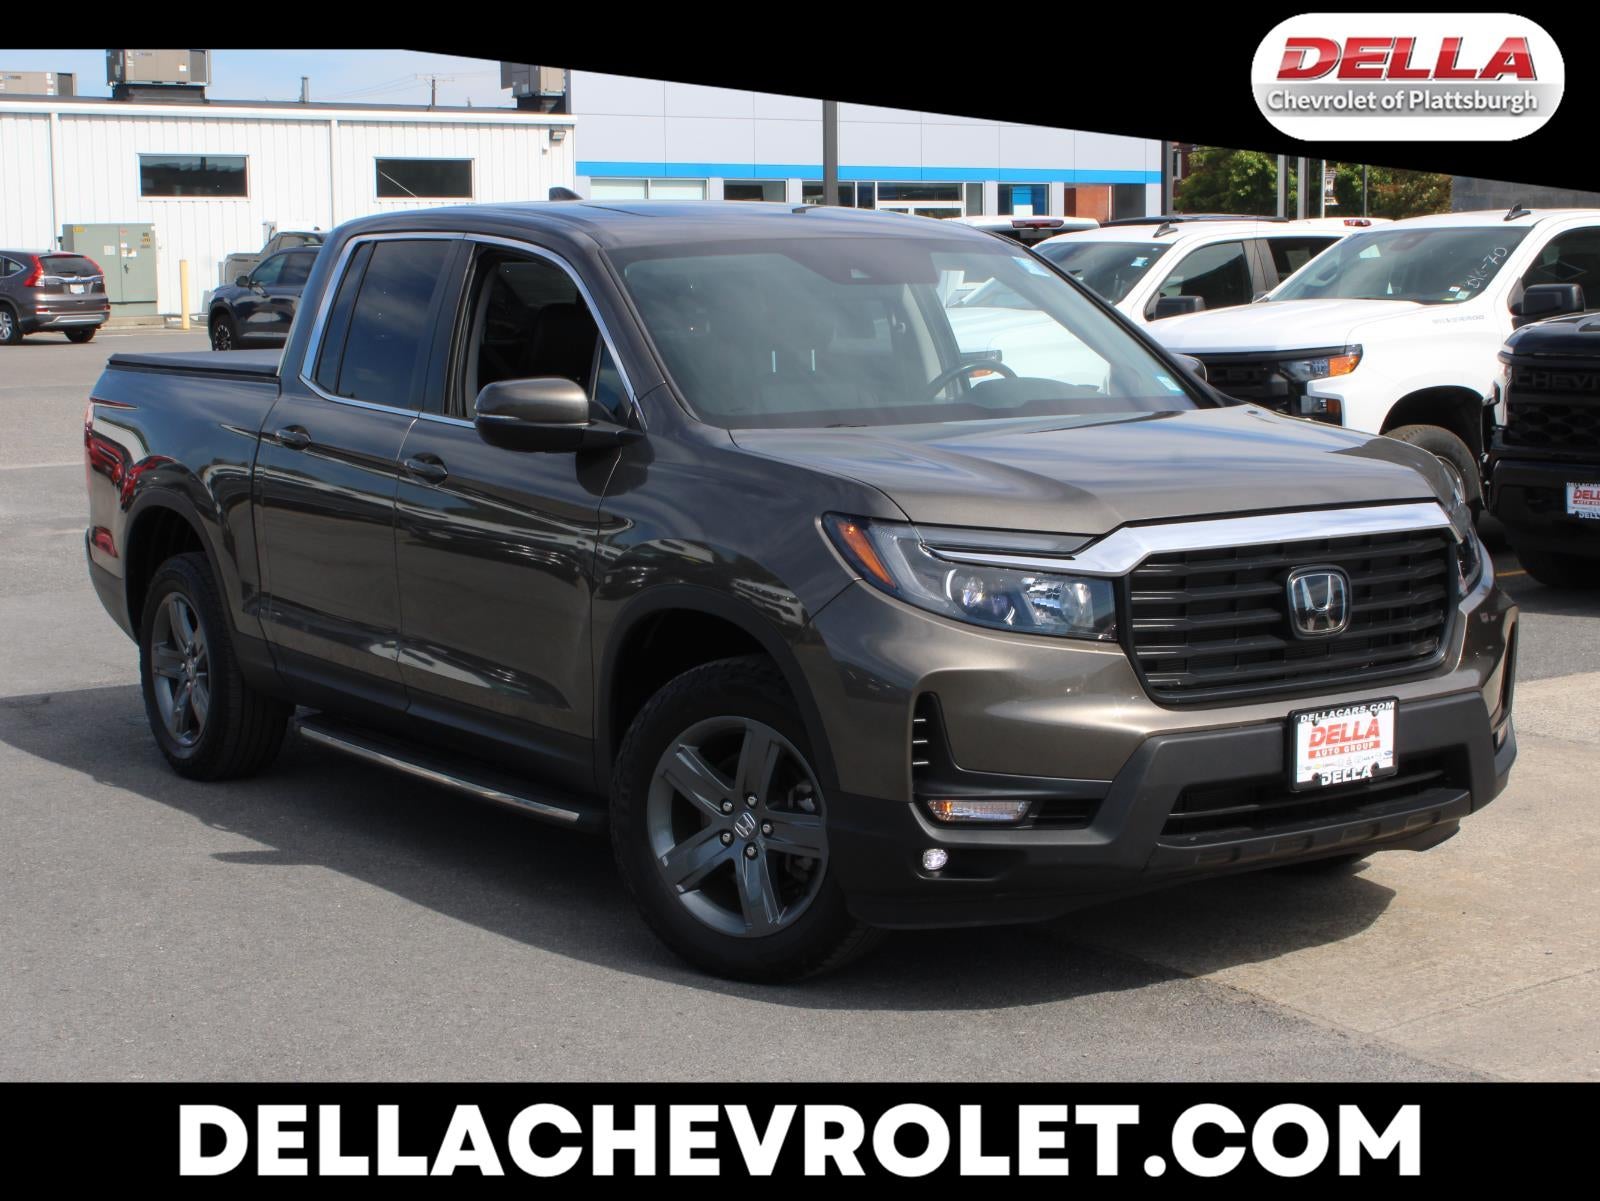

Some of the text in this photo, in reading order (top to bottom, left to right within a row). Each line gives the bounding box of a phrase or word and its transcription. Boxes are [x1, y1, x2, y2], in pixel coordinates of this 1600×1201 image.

[1300, 701, 1394, 723] DELLACARS.COM
[1308, 718, 1380, 748] DELLA
[1315, 741, 1374, 759] AUTO GROUP
[1321, 765, 1372, 786] DELLA
